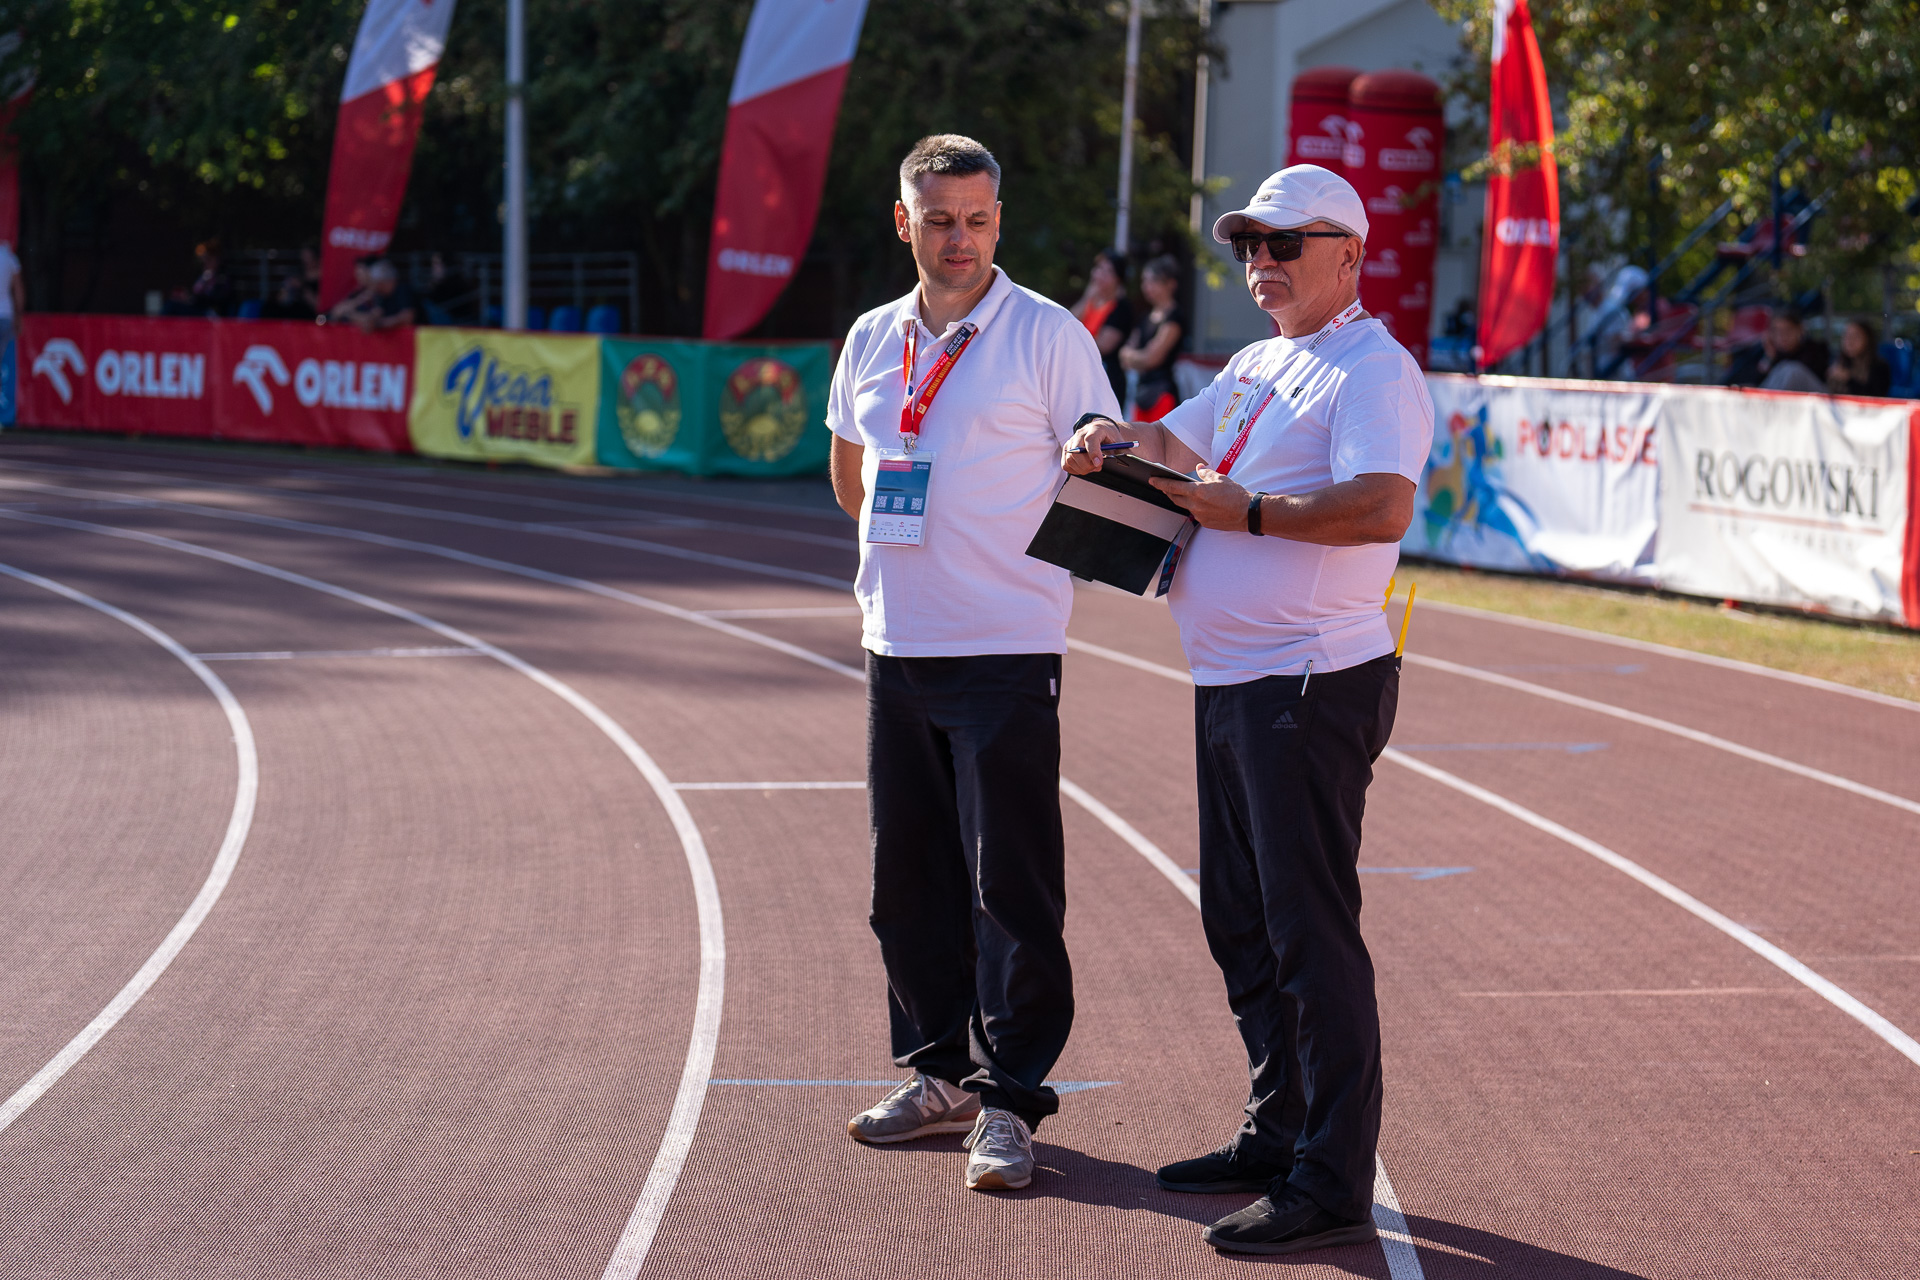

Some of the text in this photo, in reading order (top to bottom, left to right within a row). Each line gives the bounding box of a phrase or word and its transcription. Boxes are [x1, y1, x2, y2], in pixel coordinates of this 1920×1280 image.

[718, 249, 794, 276] ORLEN
[95, 349, 206, 399] ORLEN
[295, 359, 407, 413] ORLEN
[486, 404, 580, 445] MEBLE
[1696, 449, 1879, 517] ROGOWSKI
